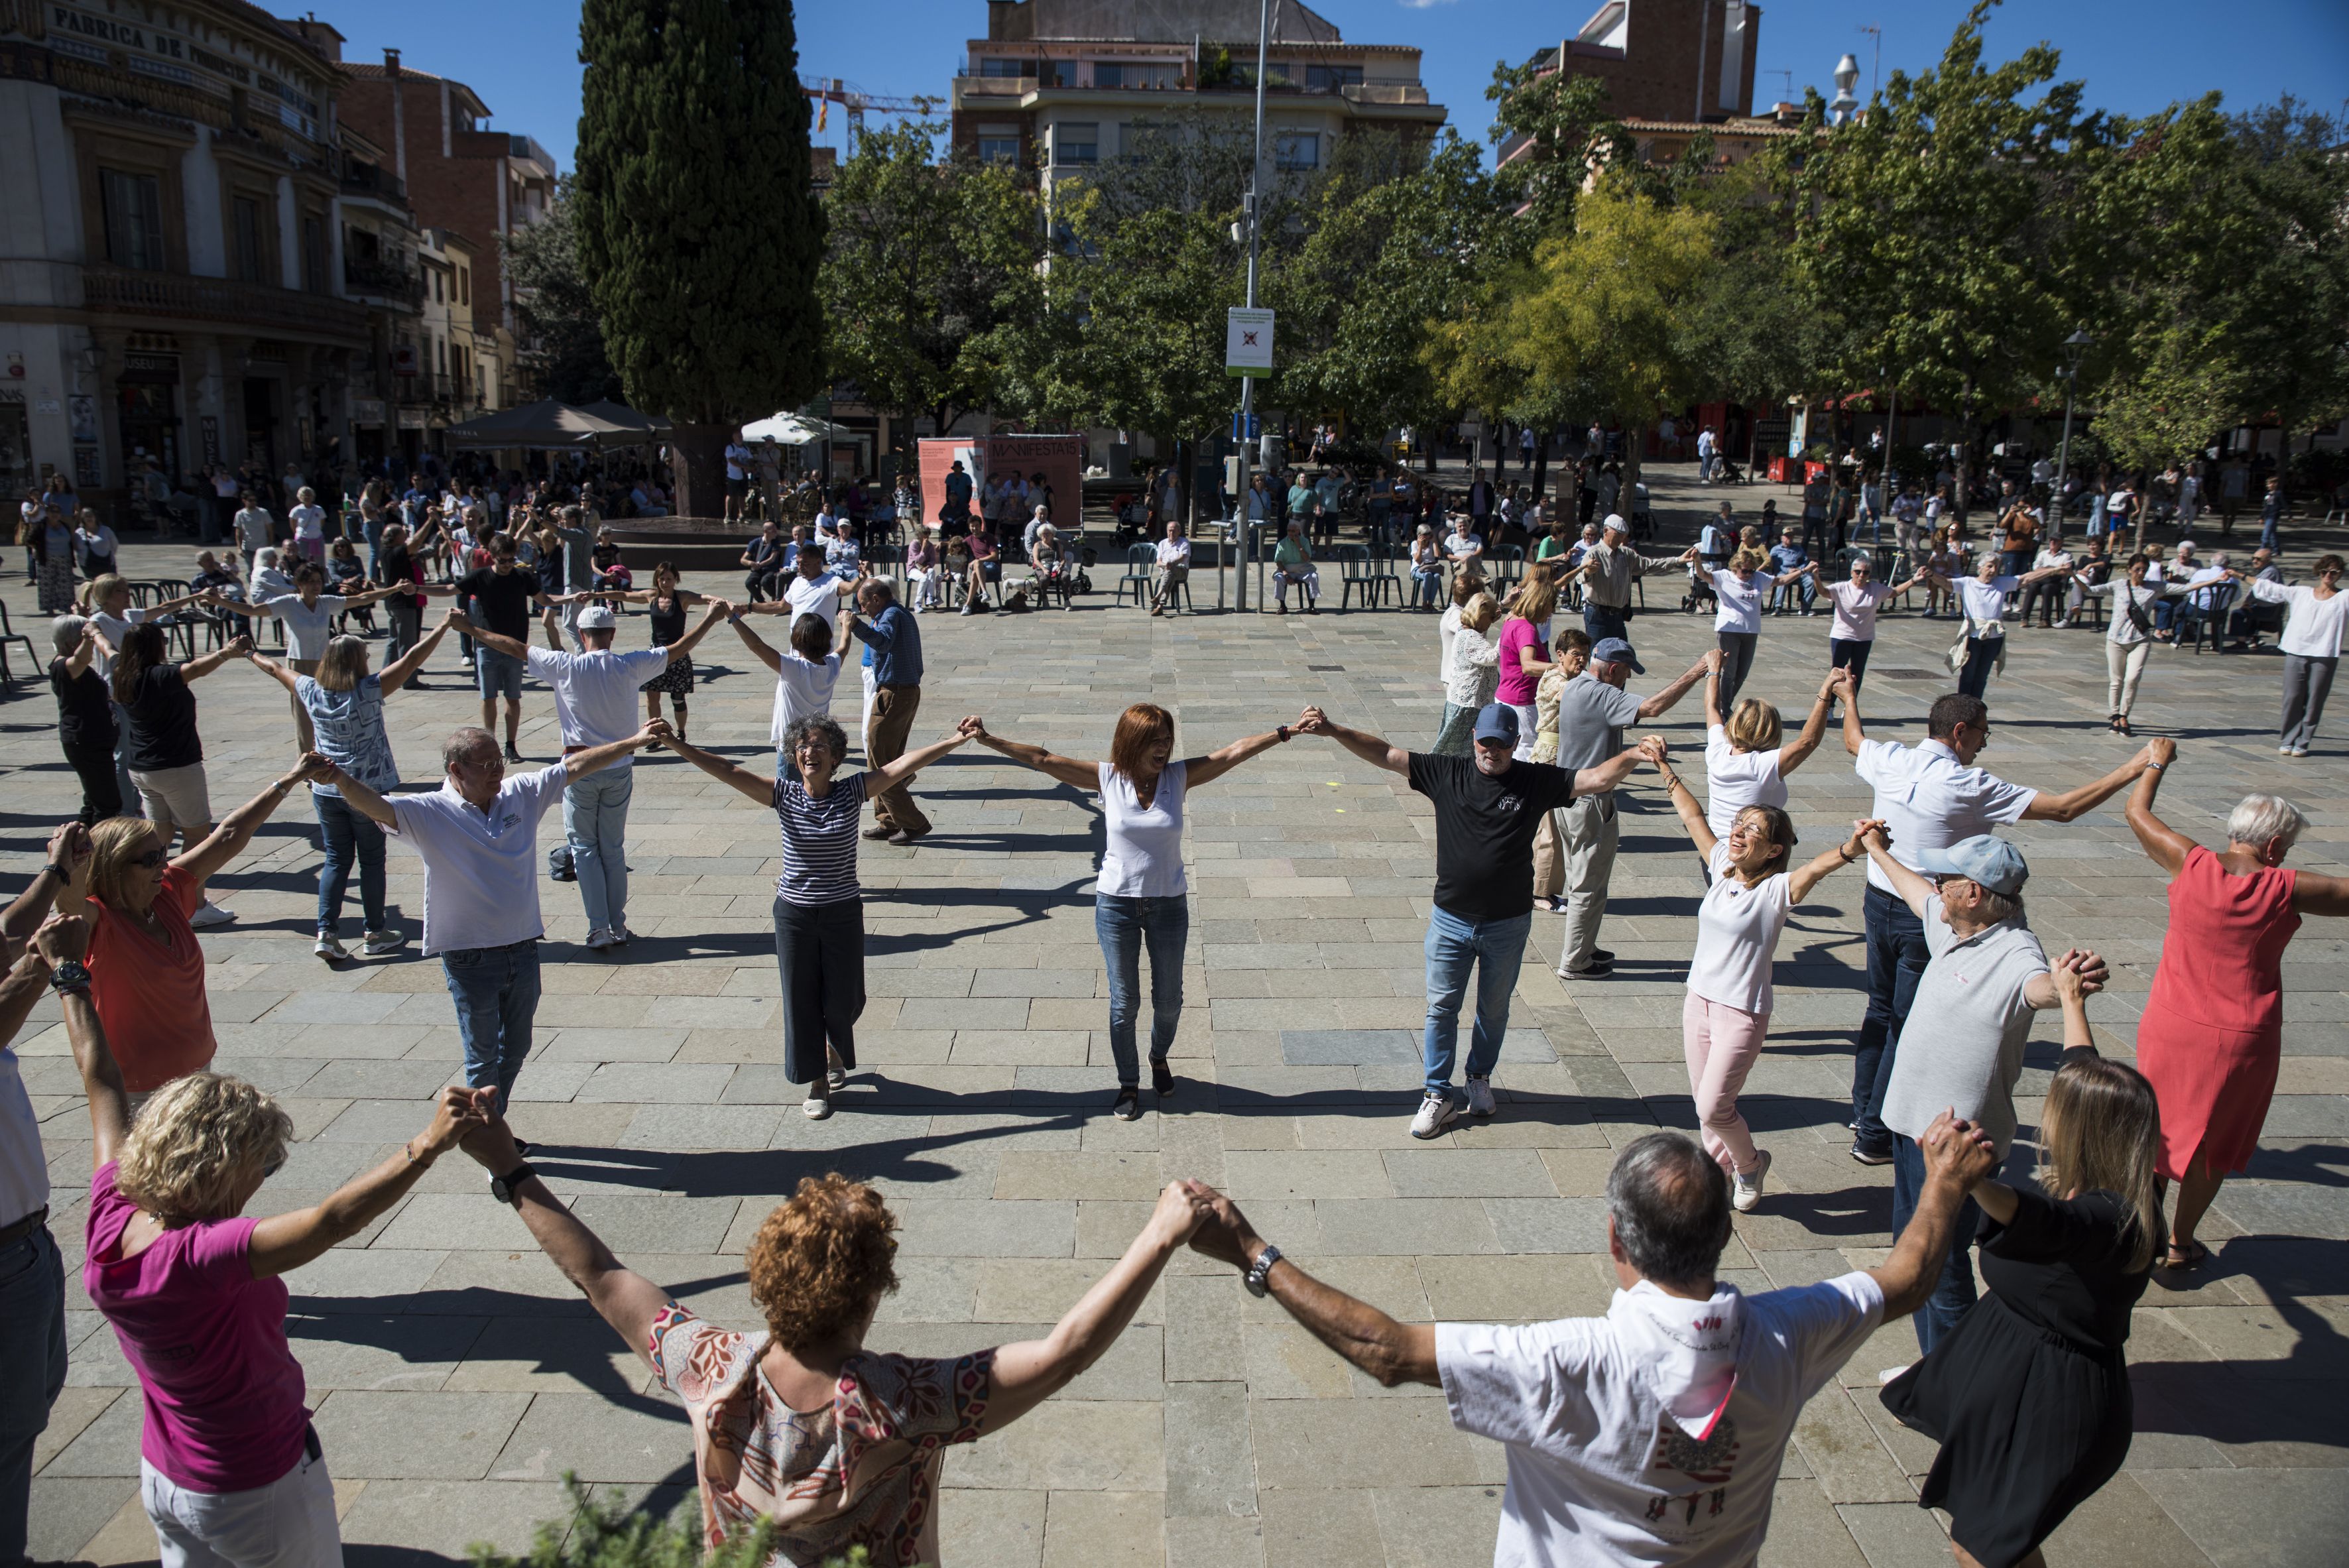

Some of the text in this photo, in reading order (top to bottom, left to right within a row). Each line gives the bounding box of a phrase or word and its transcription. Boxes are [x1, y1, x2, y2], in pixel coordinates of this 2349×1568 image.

[54, 7, 145, 48] FABRICA
[155, 35, 182, 58] DE
[125, 356, 154, 370] USEU
[201, 419, 219, 466] MUSE
